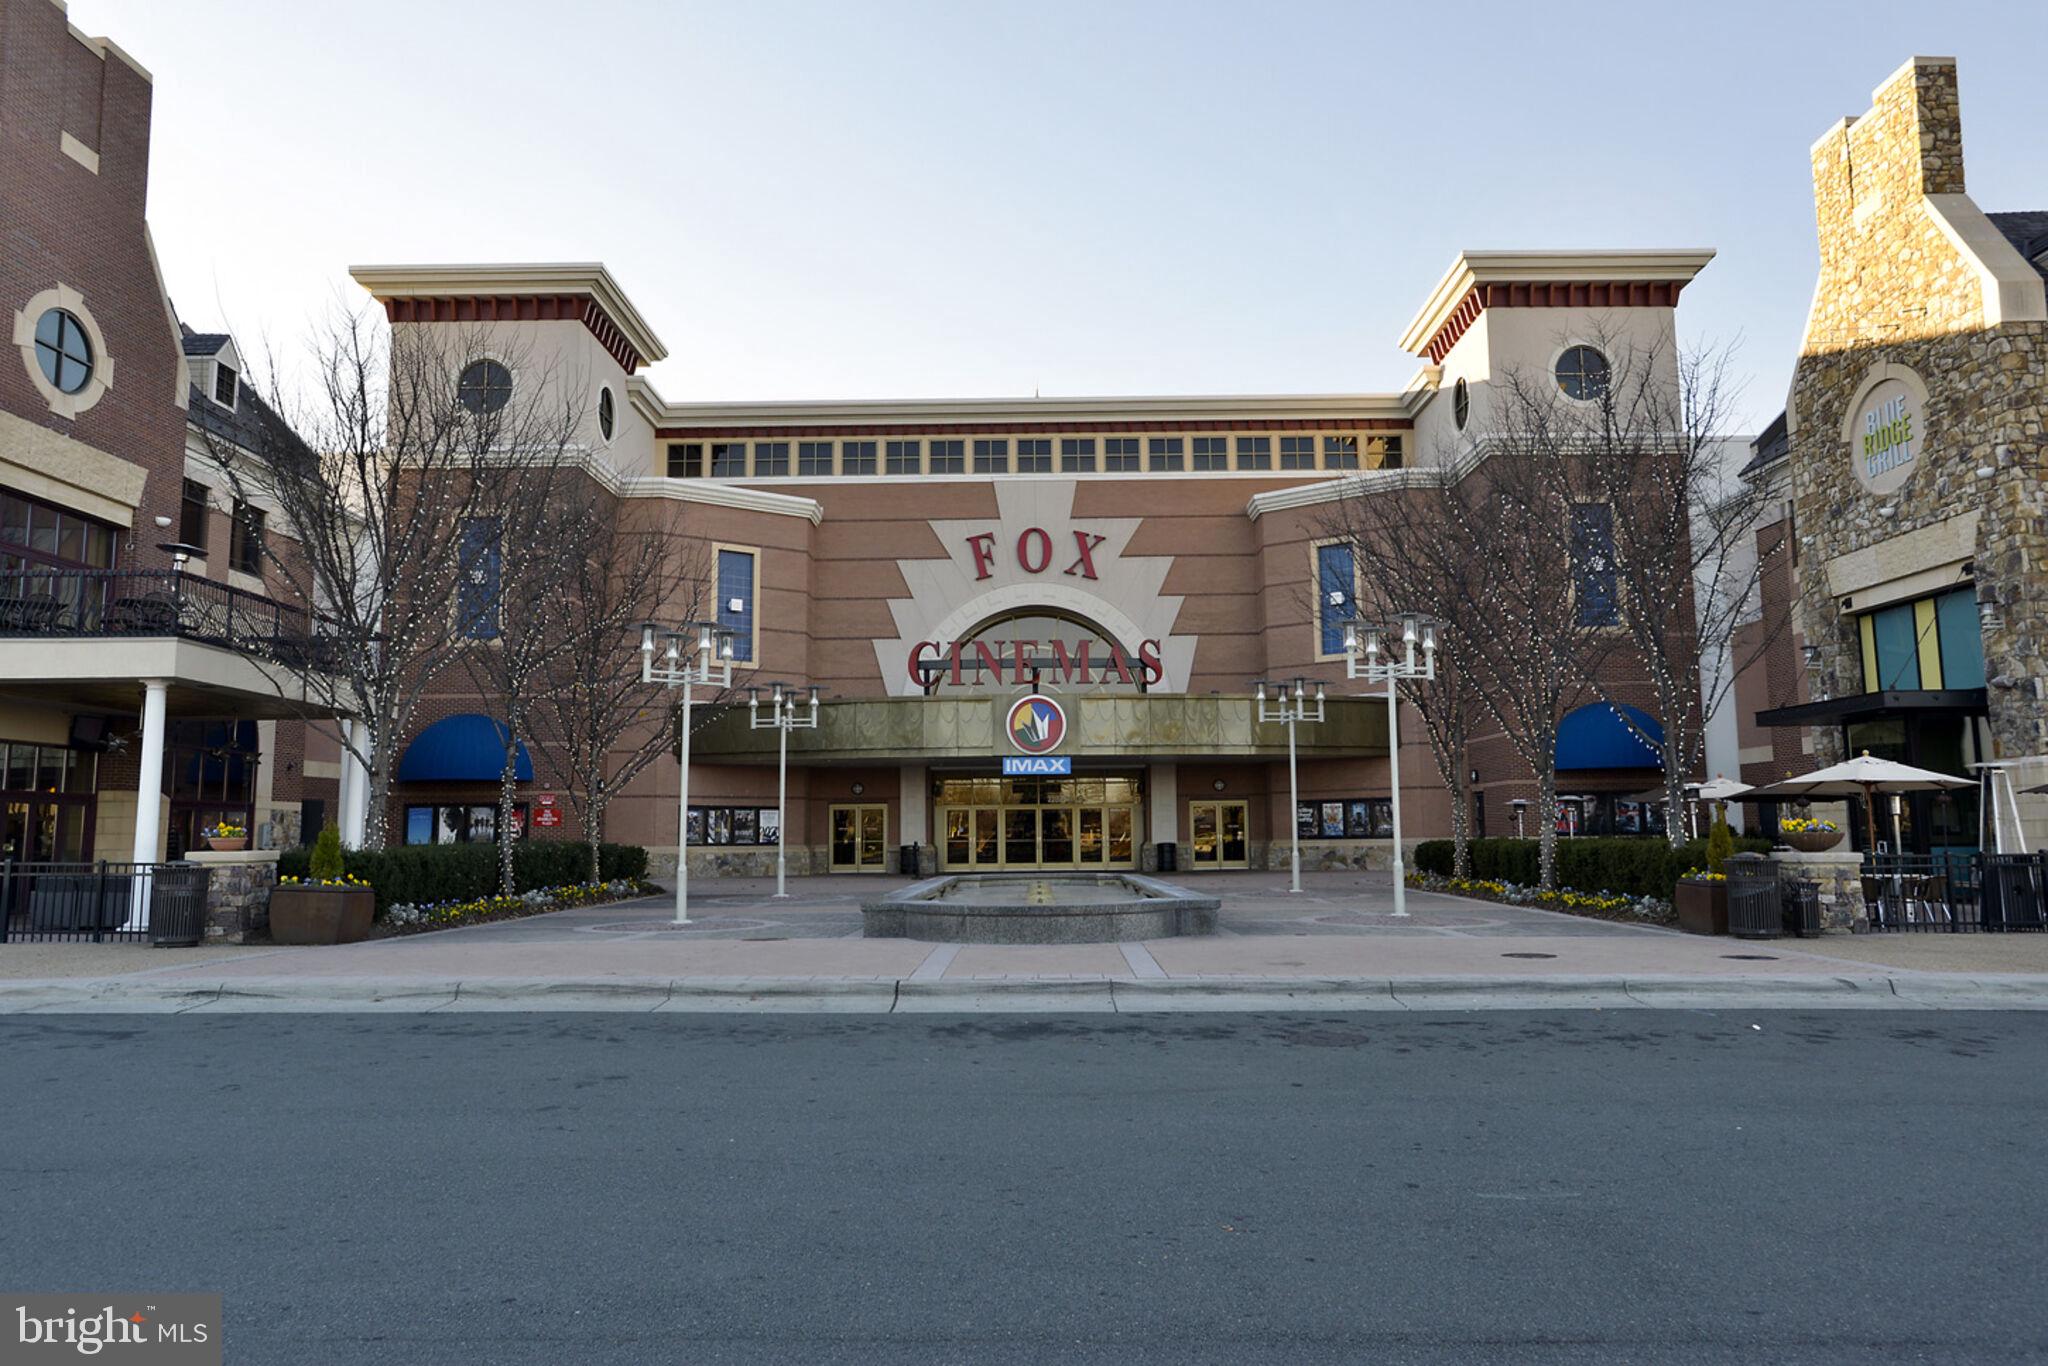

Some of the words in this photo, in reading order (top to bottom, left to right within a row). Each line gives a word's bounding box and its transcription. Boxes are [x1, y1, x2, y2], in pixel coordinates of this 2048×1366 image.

[1864, 413, 1914, 462] RIDGE
[966, 527, 1106, 581] FOX
[907, 638, 1164, 687] CINEMAS
[1005, 758, 1067, 773] IMAX
